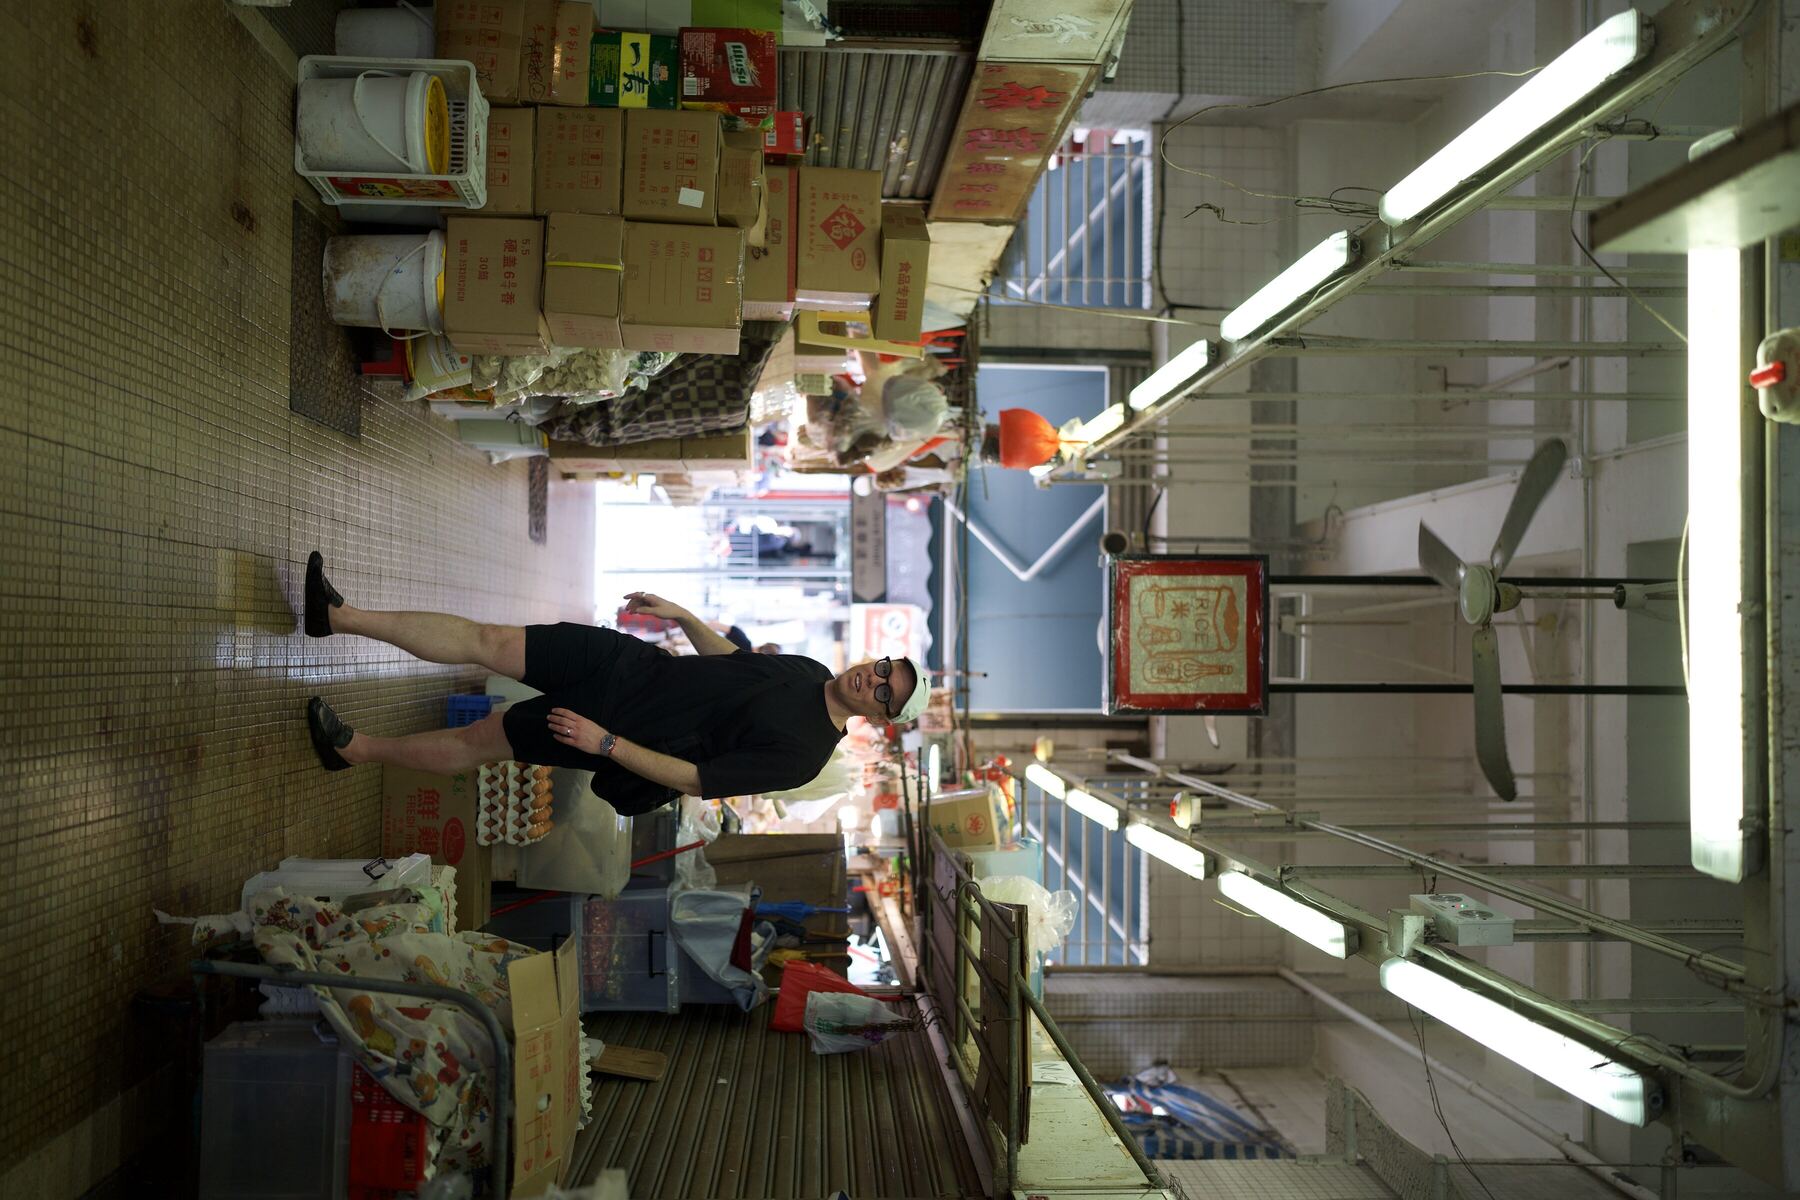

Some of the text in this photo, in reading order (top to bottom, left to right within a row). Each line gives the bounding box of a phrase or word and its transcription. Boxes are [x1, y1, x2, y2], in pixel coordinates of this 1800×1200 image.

[663, 160, 671, 170] 20
[894, 261, 912, 321] 食品专用箱
[1171, 601, 1190, 620] 米
[1195, 597, 1209, 645] RICE
[406, 795, 416, 828] FRESH
